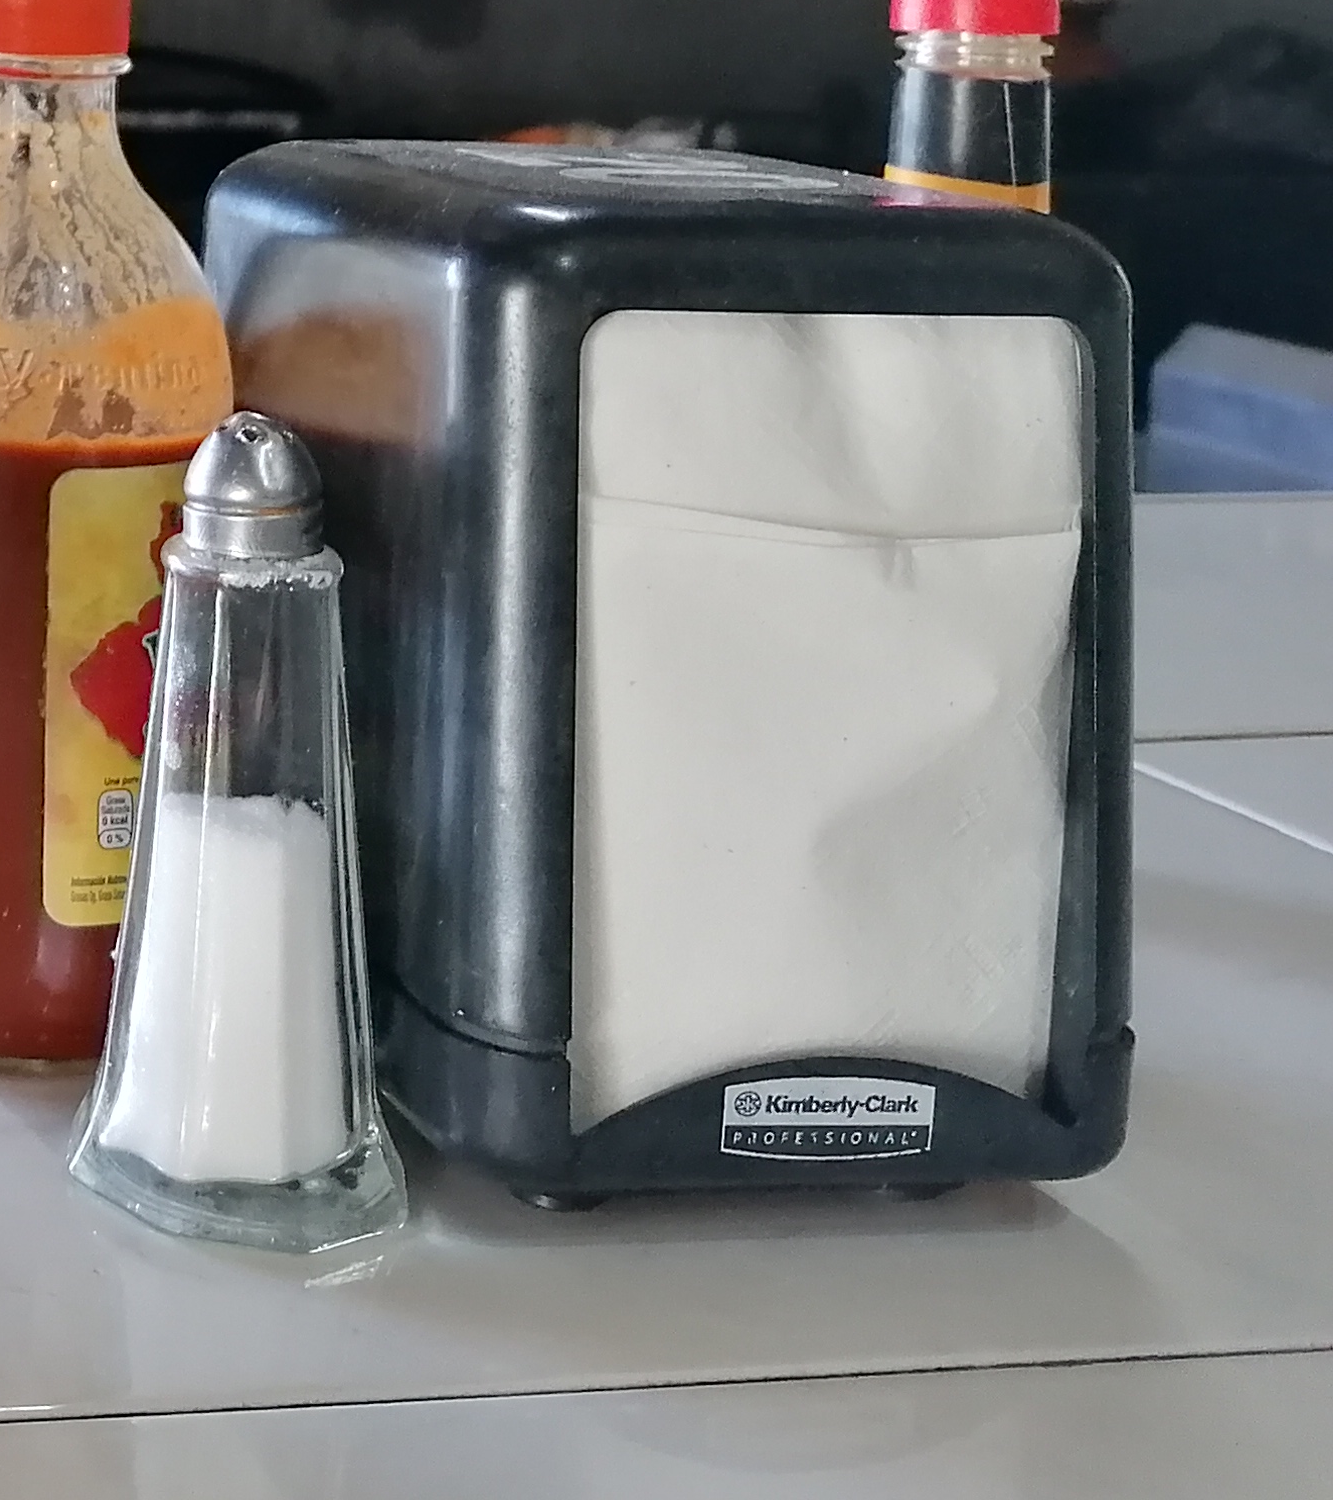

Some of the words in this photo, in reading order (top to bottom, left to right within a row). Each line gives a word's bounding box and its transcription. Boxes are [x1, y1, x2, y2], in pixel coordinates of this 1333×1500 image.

[110, 815, 129, 825] kcal
[106, 834, 113, 844] 0
[765, 1094, 919, 1118] Kimberly-Clark
